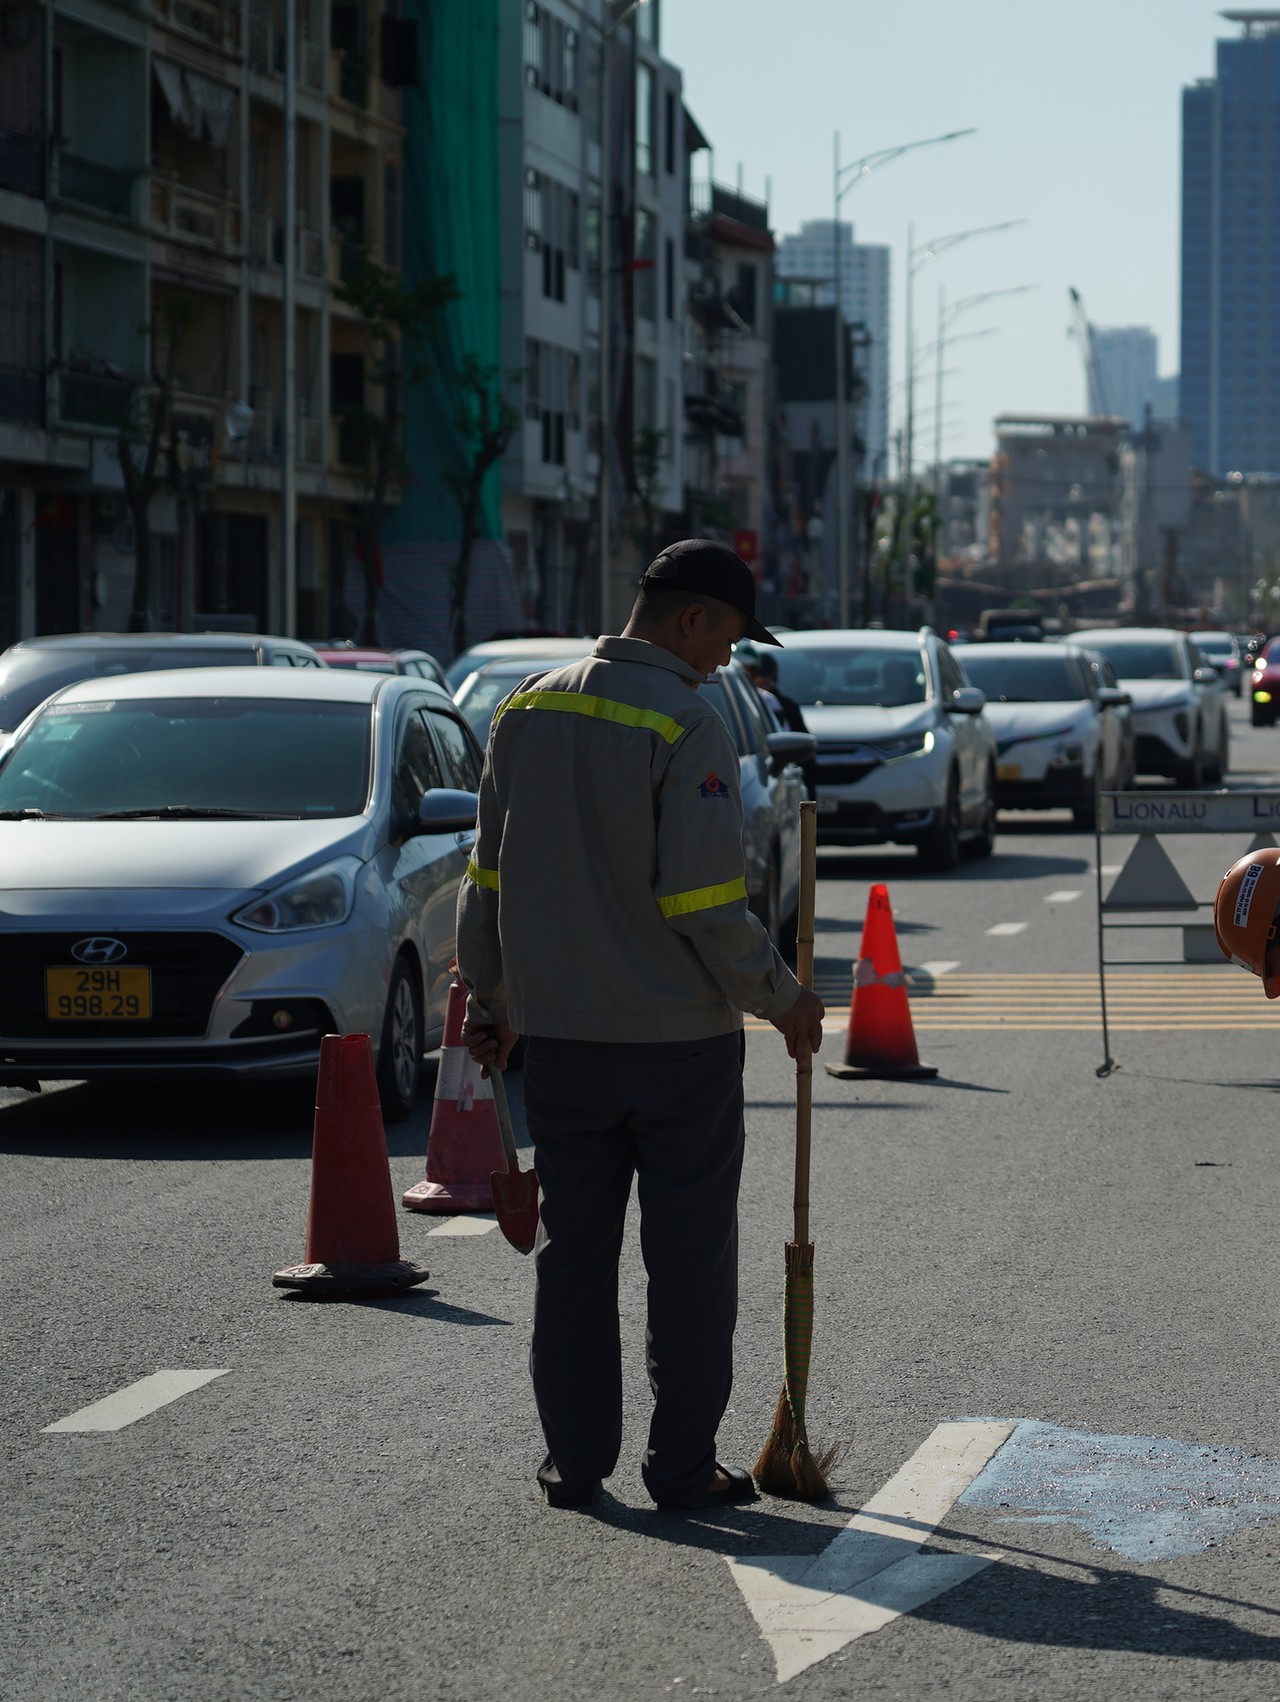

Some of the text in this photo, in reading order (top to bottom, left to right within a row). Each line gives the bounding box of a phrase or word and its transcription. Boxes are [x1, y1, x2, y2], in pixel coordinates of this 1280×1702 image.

[1247, 865, 1261, 878] 68
[76, 970, 120, 992] 29H
[58, 994, 140, 1017] 998.29
